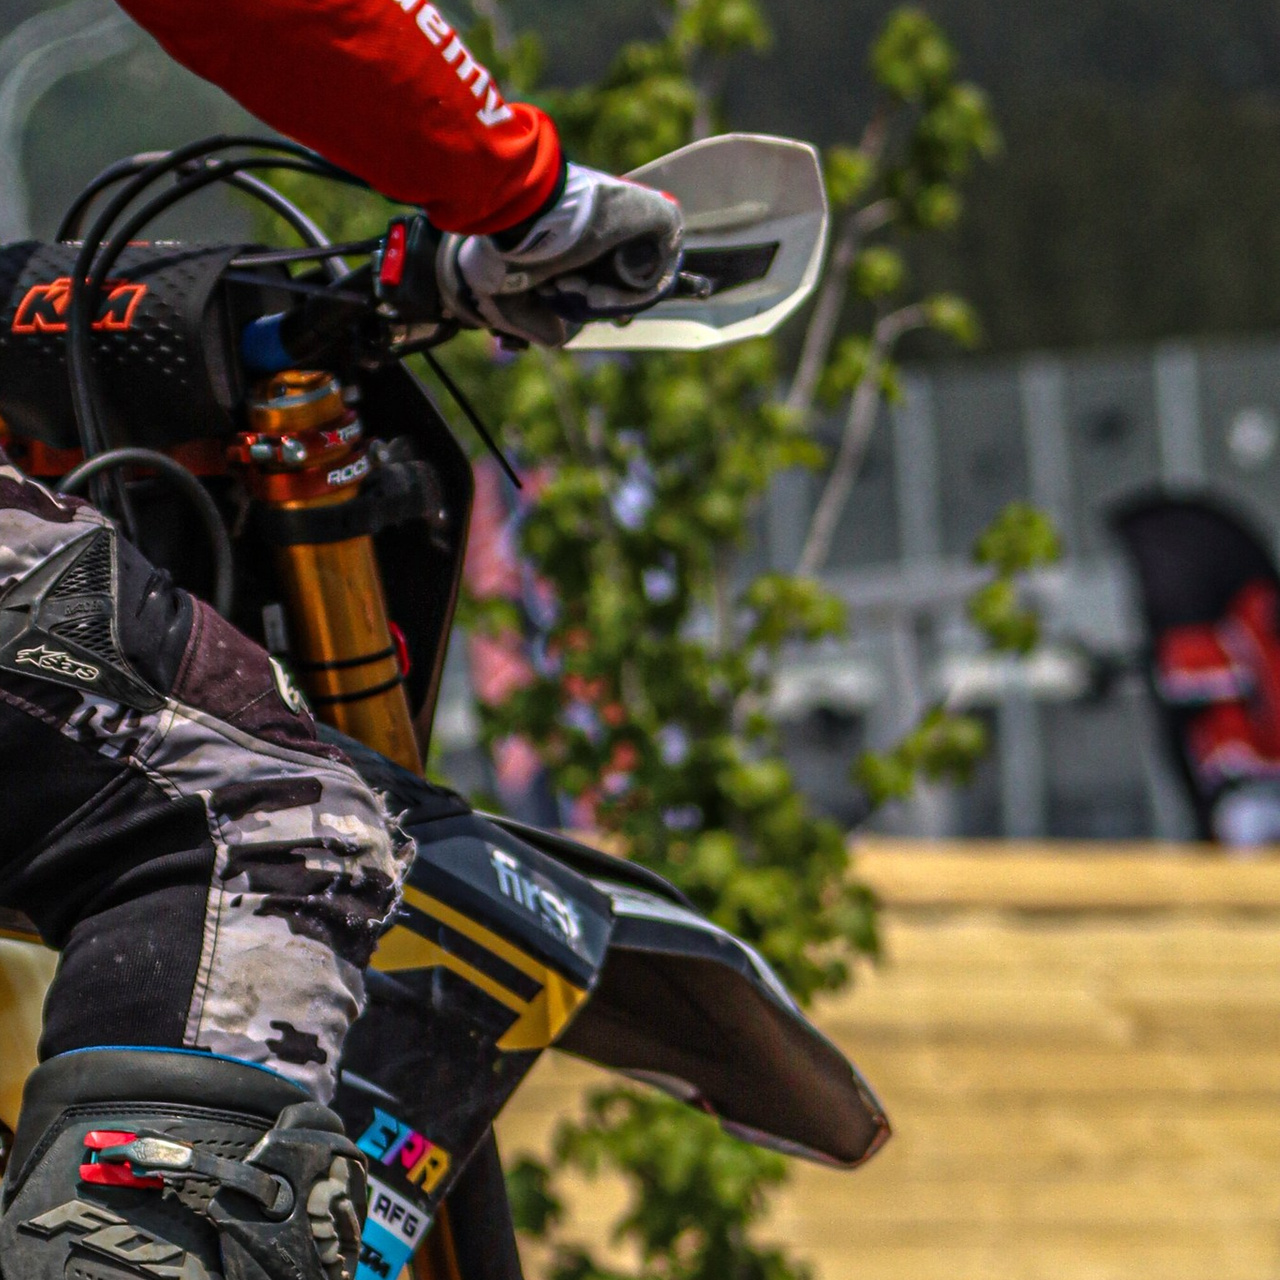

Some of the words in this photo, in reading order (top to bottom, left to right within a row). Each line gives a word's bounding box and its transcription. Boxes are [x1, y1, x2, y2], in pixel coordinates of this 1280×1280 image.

[12, 277, 147, 333] KM
[373, 1192, 418, 1238] AFG
[360, 1240, 391, 1279] TM
